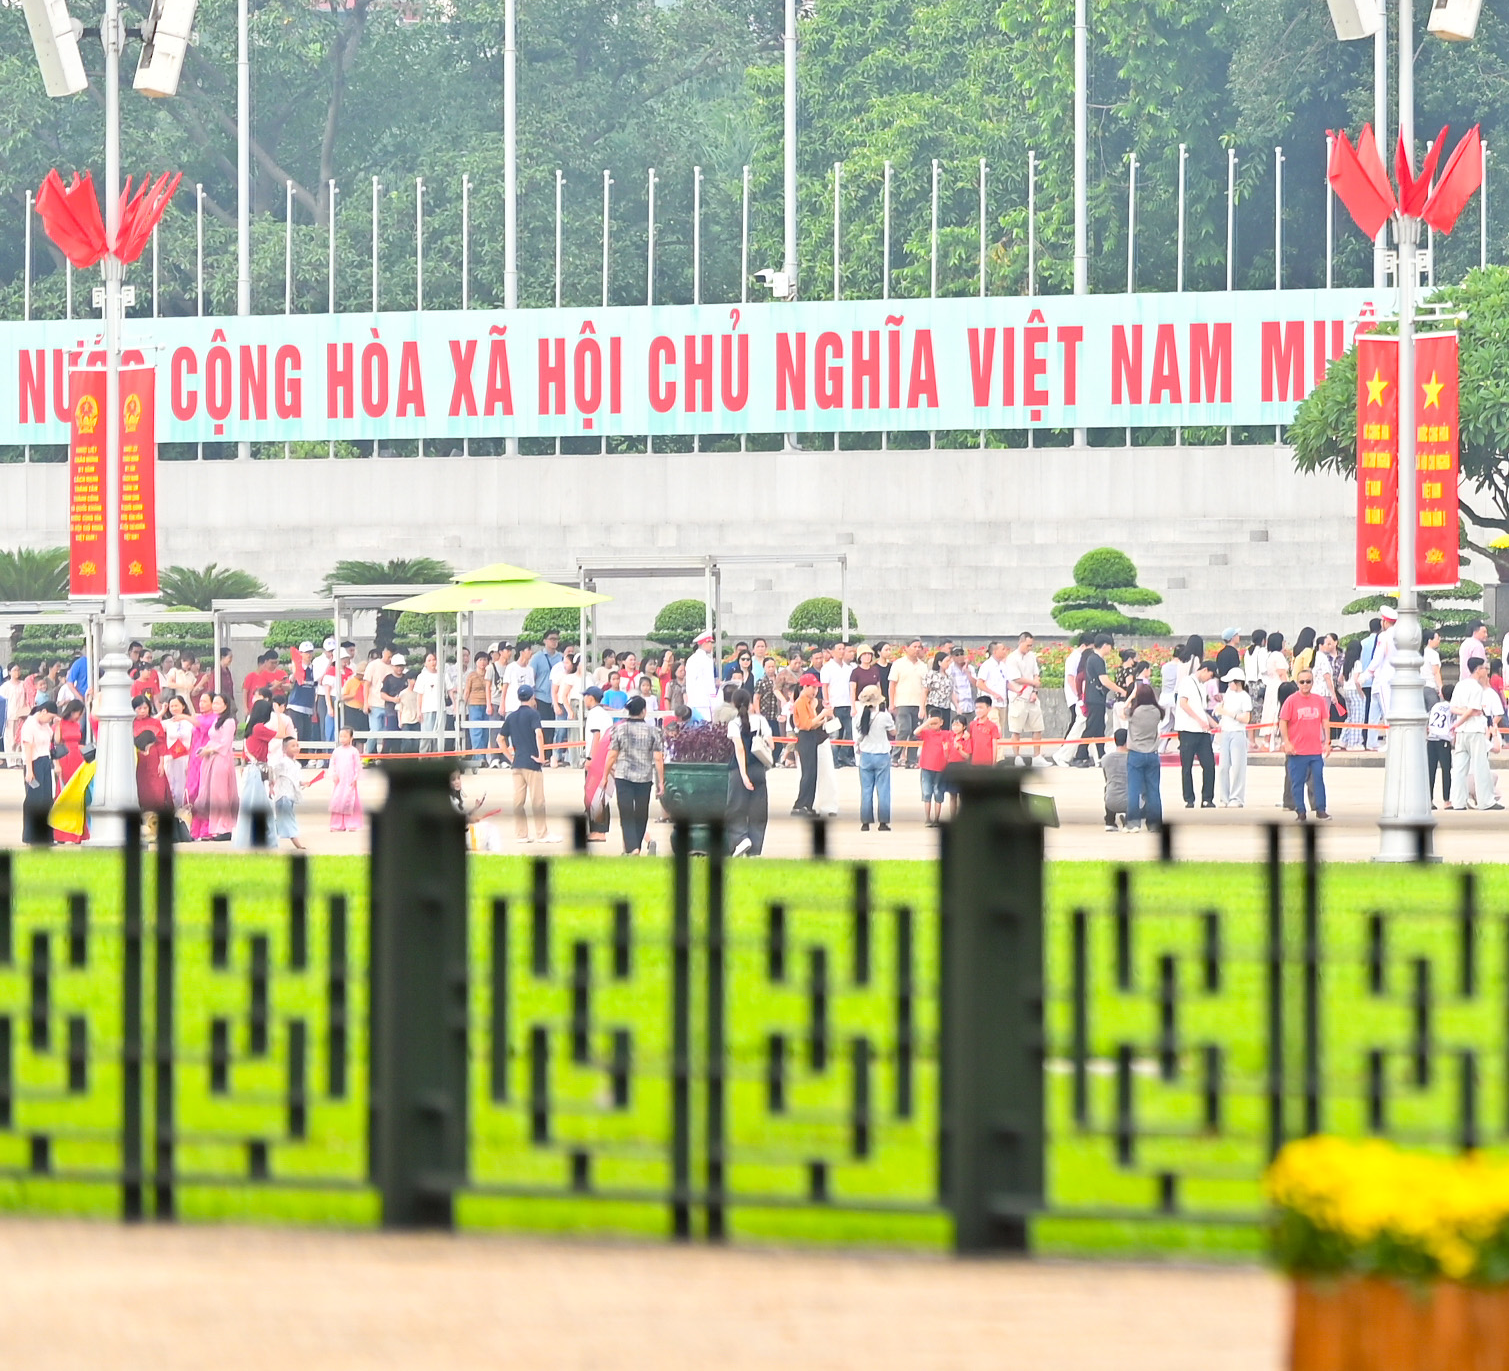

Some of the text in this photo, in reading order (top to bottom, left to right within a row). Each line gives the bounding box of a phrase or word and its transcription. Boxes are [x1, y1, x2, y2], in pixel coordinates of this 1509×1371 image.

[171, 328, 302, 435] CỘNG
[327, 327, 426, 419] HÒA
[449, 325, 514, 418] XÃ
[539, 320, 622, 430] HỘI
[648, 309, 749, 414] CHỦ
[775, 314, 939, 412] NGHĨA
[967, 309, 1083, 422] VIỆT
[1112, 322, 1232, 405] NAM
[1430, 712, 1447, 728] 23
